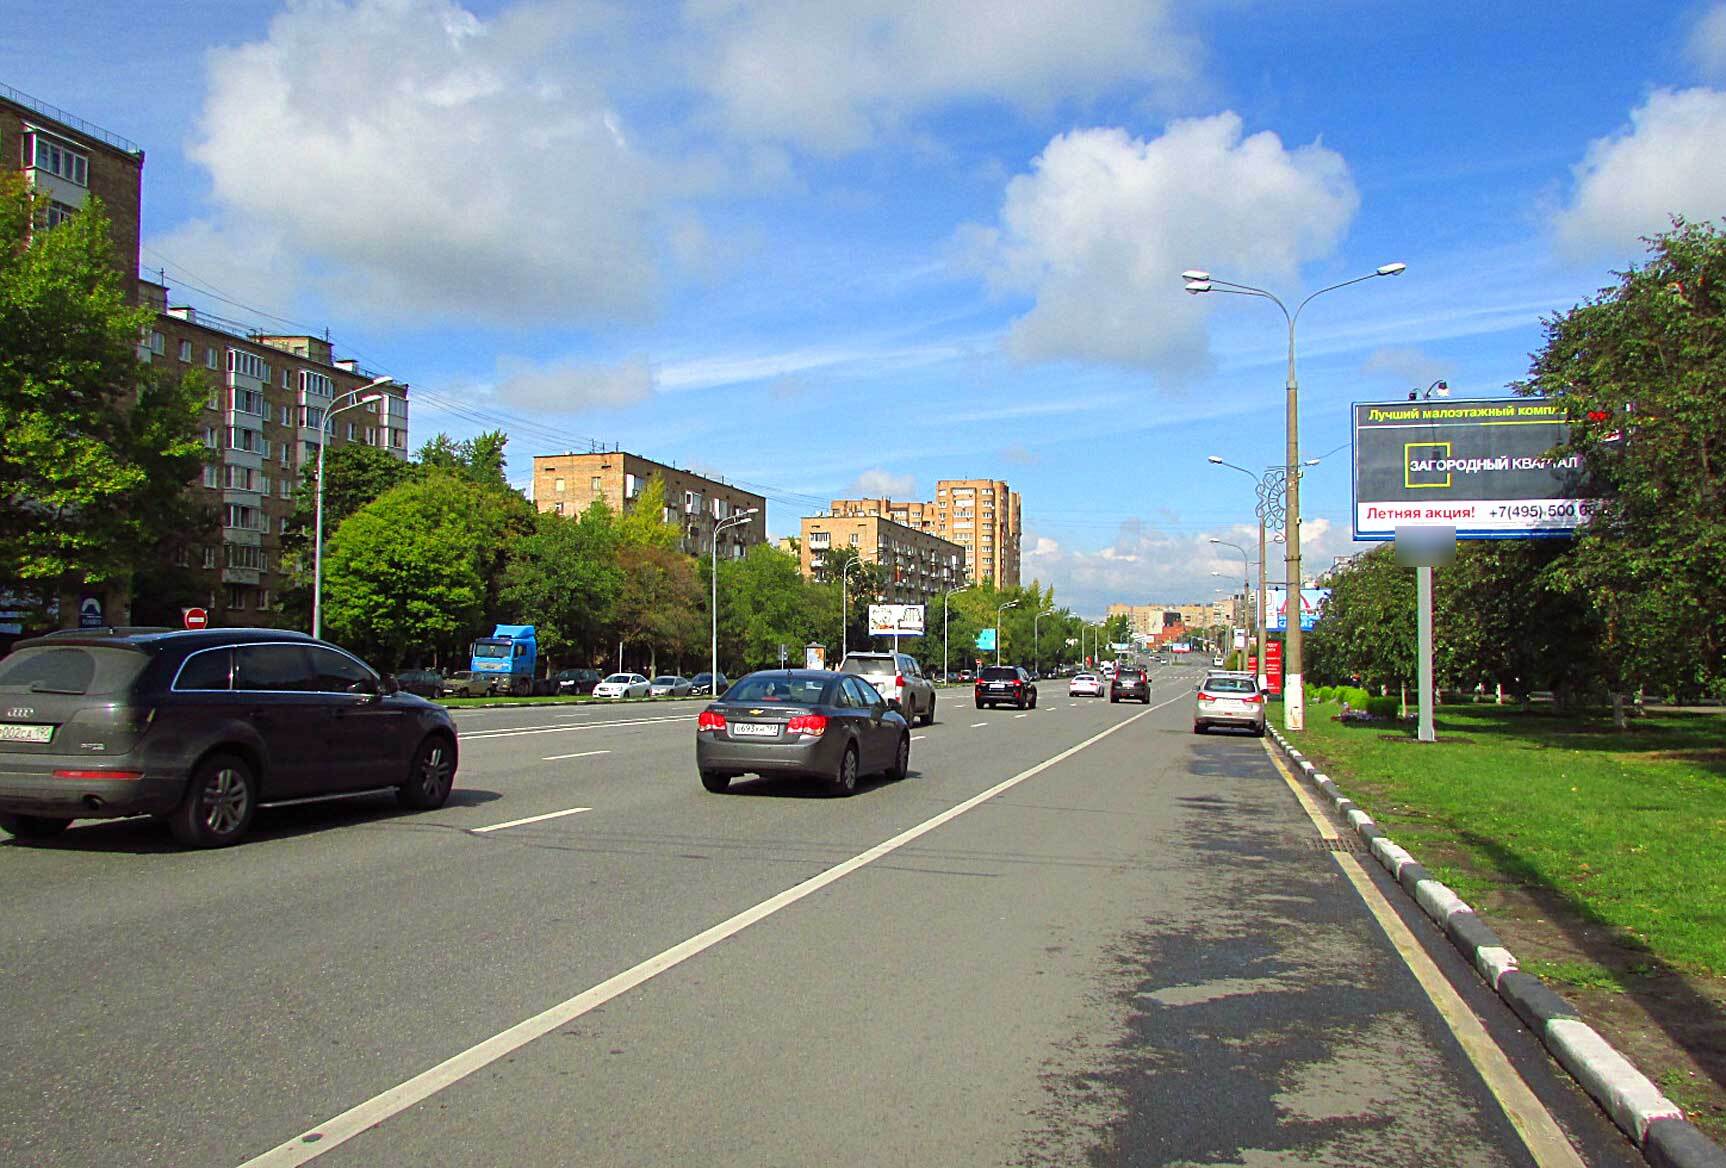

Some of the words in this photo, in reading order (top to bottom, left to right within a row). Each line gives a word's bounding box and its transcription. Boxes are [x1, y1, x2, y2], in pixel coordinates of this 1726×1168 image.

[1368, 408, 1419, 422] Лучший
[1422, 405, 1514, 419] малоэтажный
[1410, 456, 1508, 474] ЗАГОРОДНЫЙ
[1367, 507, 1421, 519] Летняя
[1425, 506, 1475, 520] акция!
[1489, 505, 1543, 519] +7(495)
[1548, 504, 1575, 517] 500
